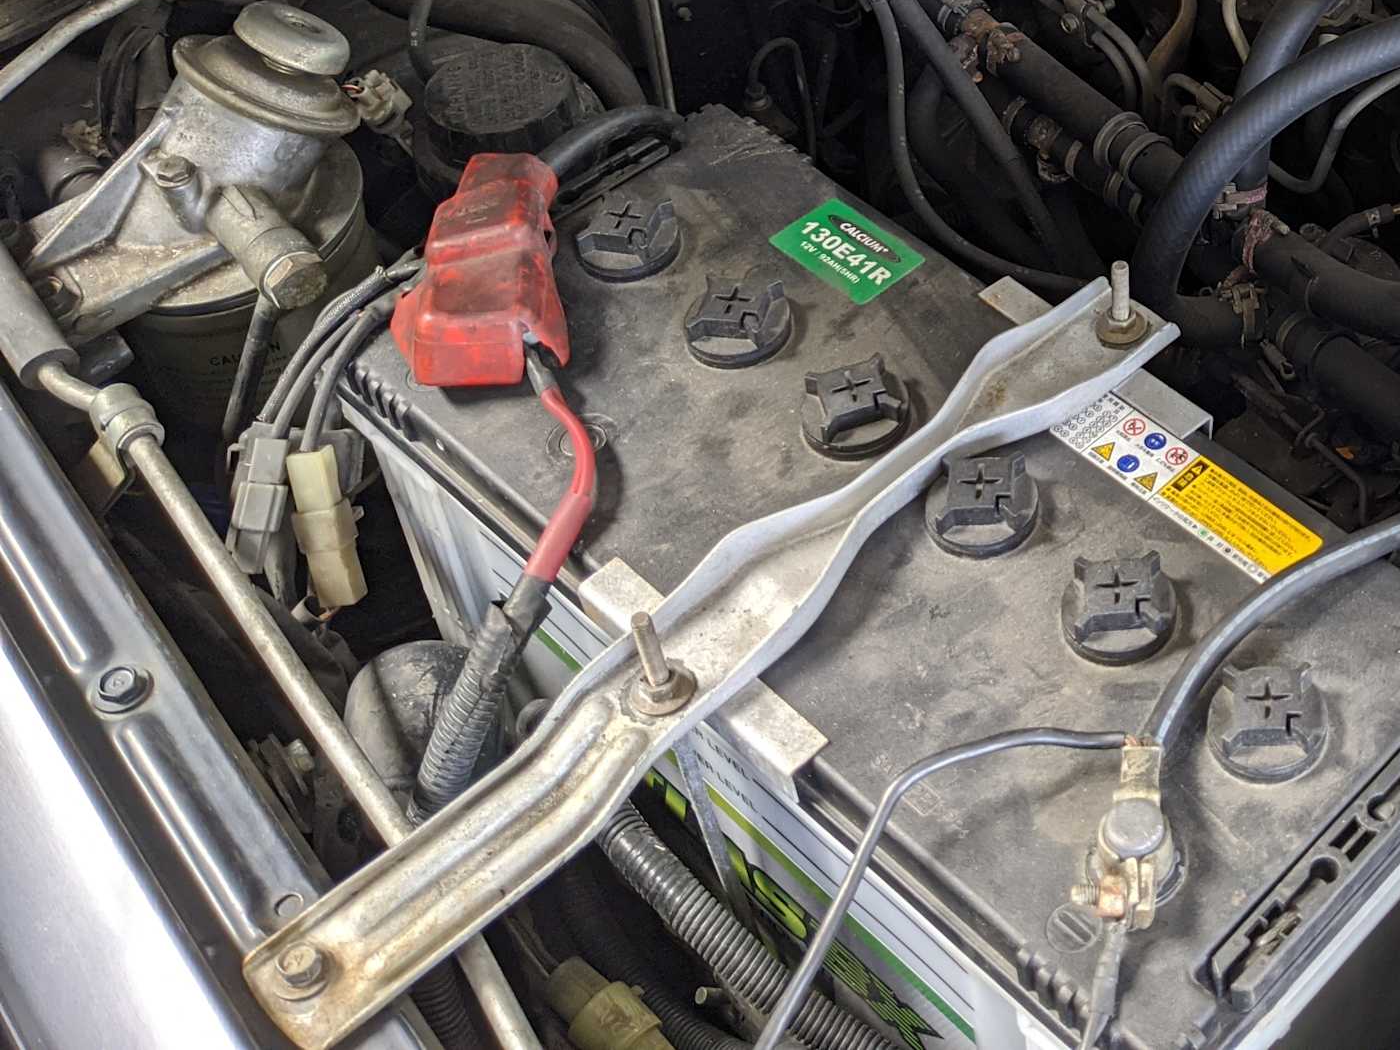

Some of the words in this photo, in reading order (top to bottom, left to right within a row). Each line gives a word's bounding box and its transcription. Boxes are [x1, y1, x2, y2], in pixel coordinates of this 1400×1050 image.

[799, 241, 817, 253] 12V
[801, 221, 892, 286] 130E41R
[706, 738, 751, 781] LEVEL
[716, 771, 759, 813] LEVEL
